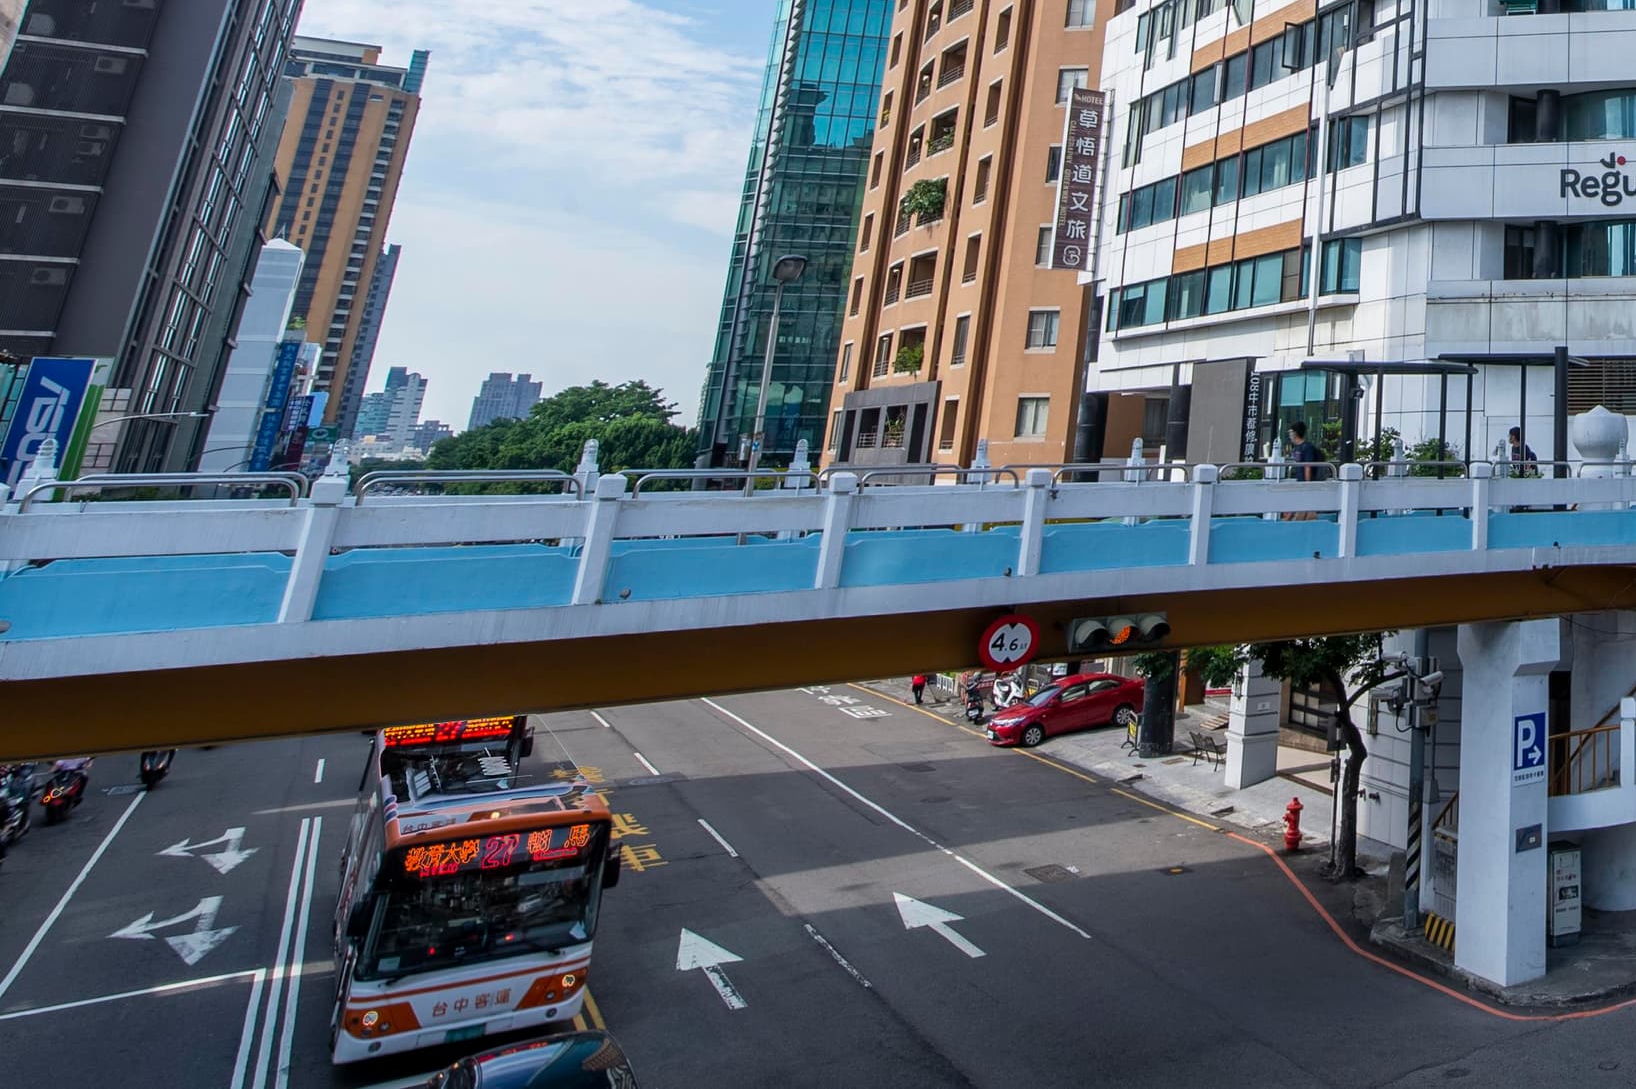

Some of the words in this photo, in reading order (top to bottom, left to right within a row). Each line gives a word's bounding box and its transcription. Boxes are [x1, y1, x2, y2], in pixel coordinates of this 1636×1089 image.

[1081, 94, 1104, 105] HOTEL
[1066, 109, 1099, 240] 草悟道文旅
[991, 632, 1019, 652] 4.6
[1516, 719, 1537, 768] P
[481, 833, 521, 869] 27
[432, 987, 512, 1017] 台中客運
